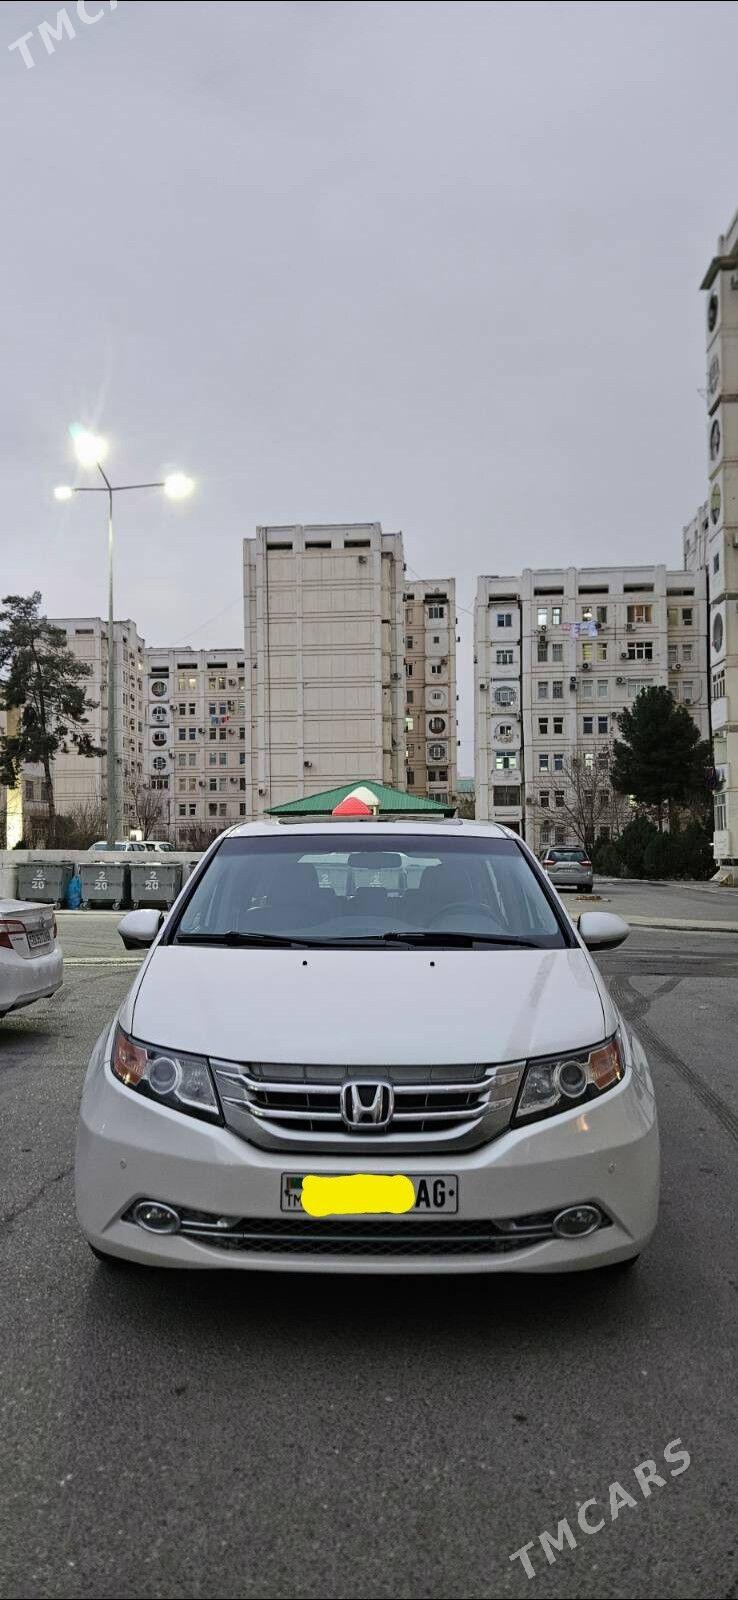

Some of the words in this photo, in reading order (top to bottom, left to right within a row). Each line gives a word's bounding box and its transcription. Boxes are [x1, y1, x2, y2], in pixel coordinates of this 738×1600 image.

[36, 870, 44, 878] 2
[98, 871, 106, 880] 2
[149, 871, 157, 880] 2
[31, 880, 45, 890] 20
[94, 881, 108, 891] 20
[144, 881, 159, 891] 20
[415, 1179, 446, 1208] AG
